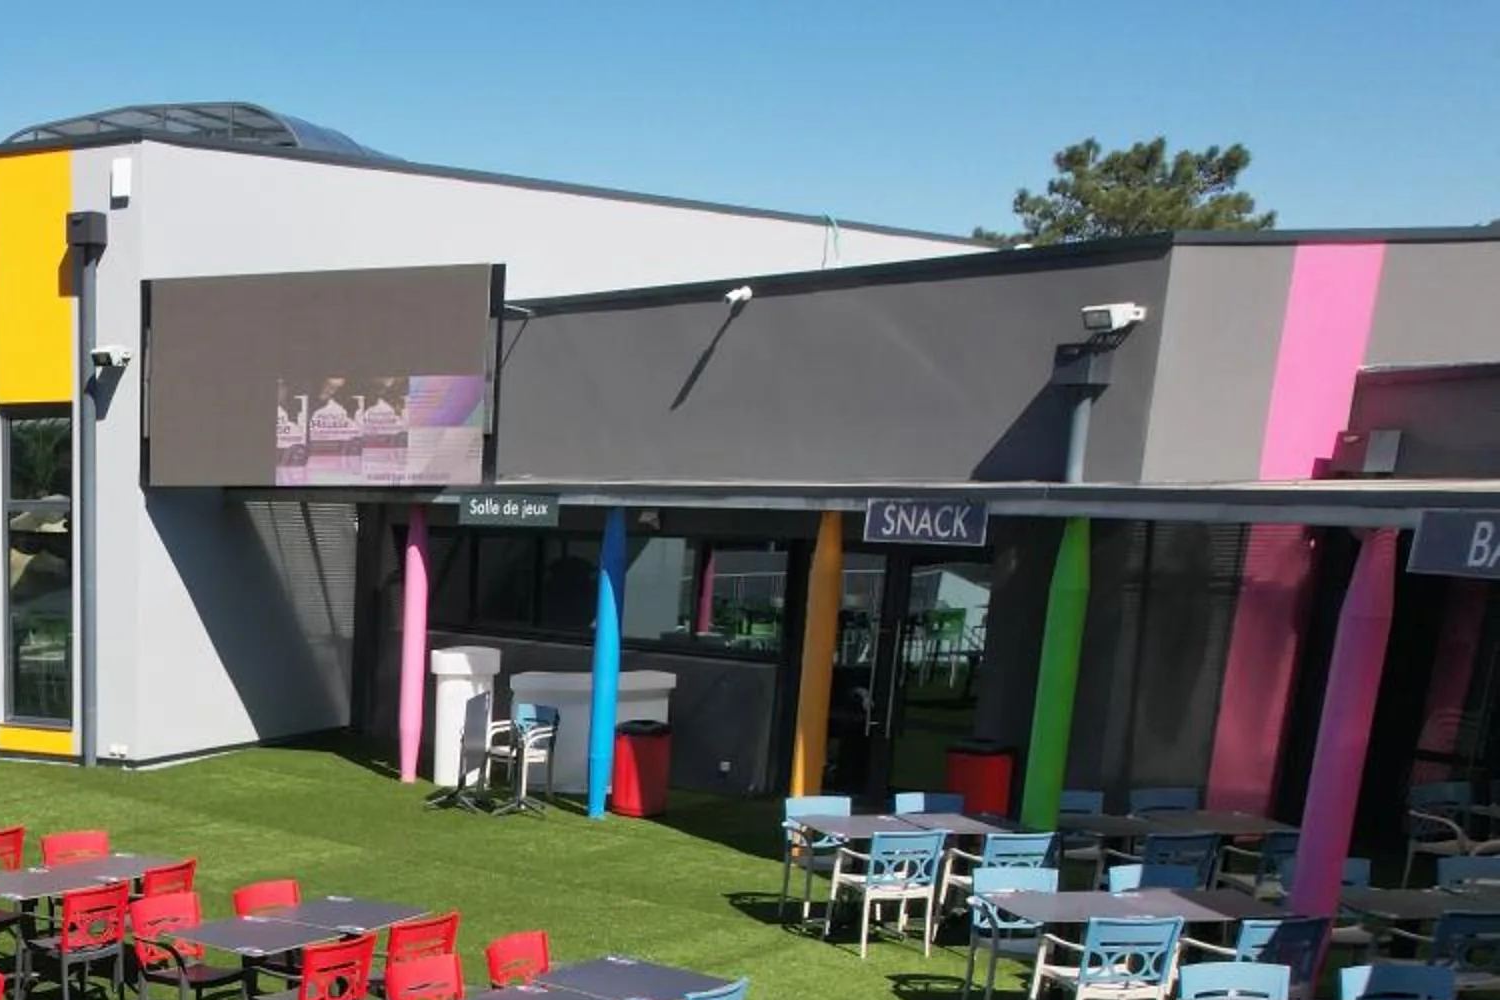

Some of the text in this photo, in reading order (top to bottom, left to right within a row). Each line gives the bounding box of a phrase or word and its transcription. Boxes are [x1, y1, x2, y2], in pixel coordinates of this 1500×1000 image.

[469, 495, 549, 519] Salle de jeux
[881, 503, 972, 538] SNACK
